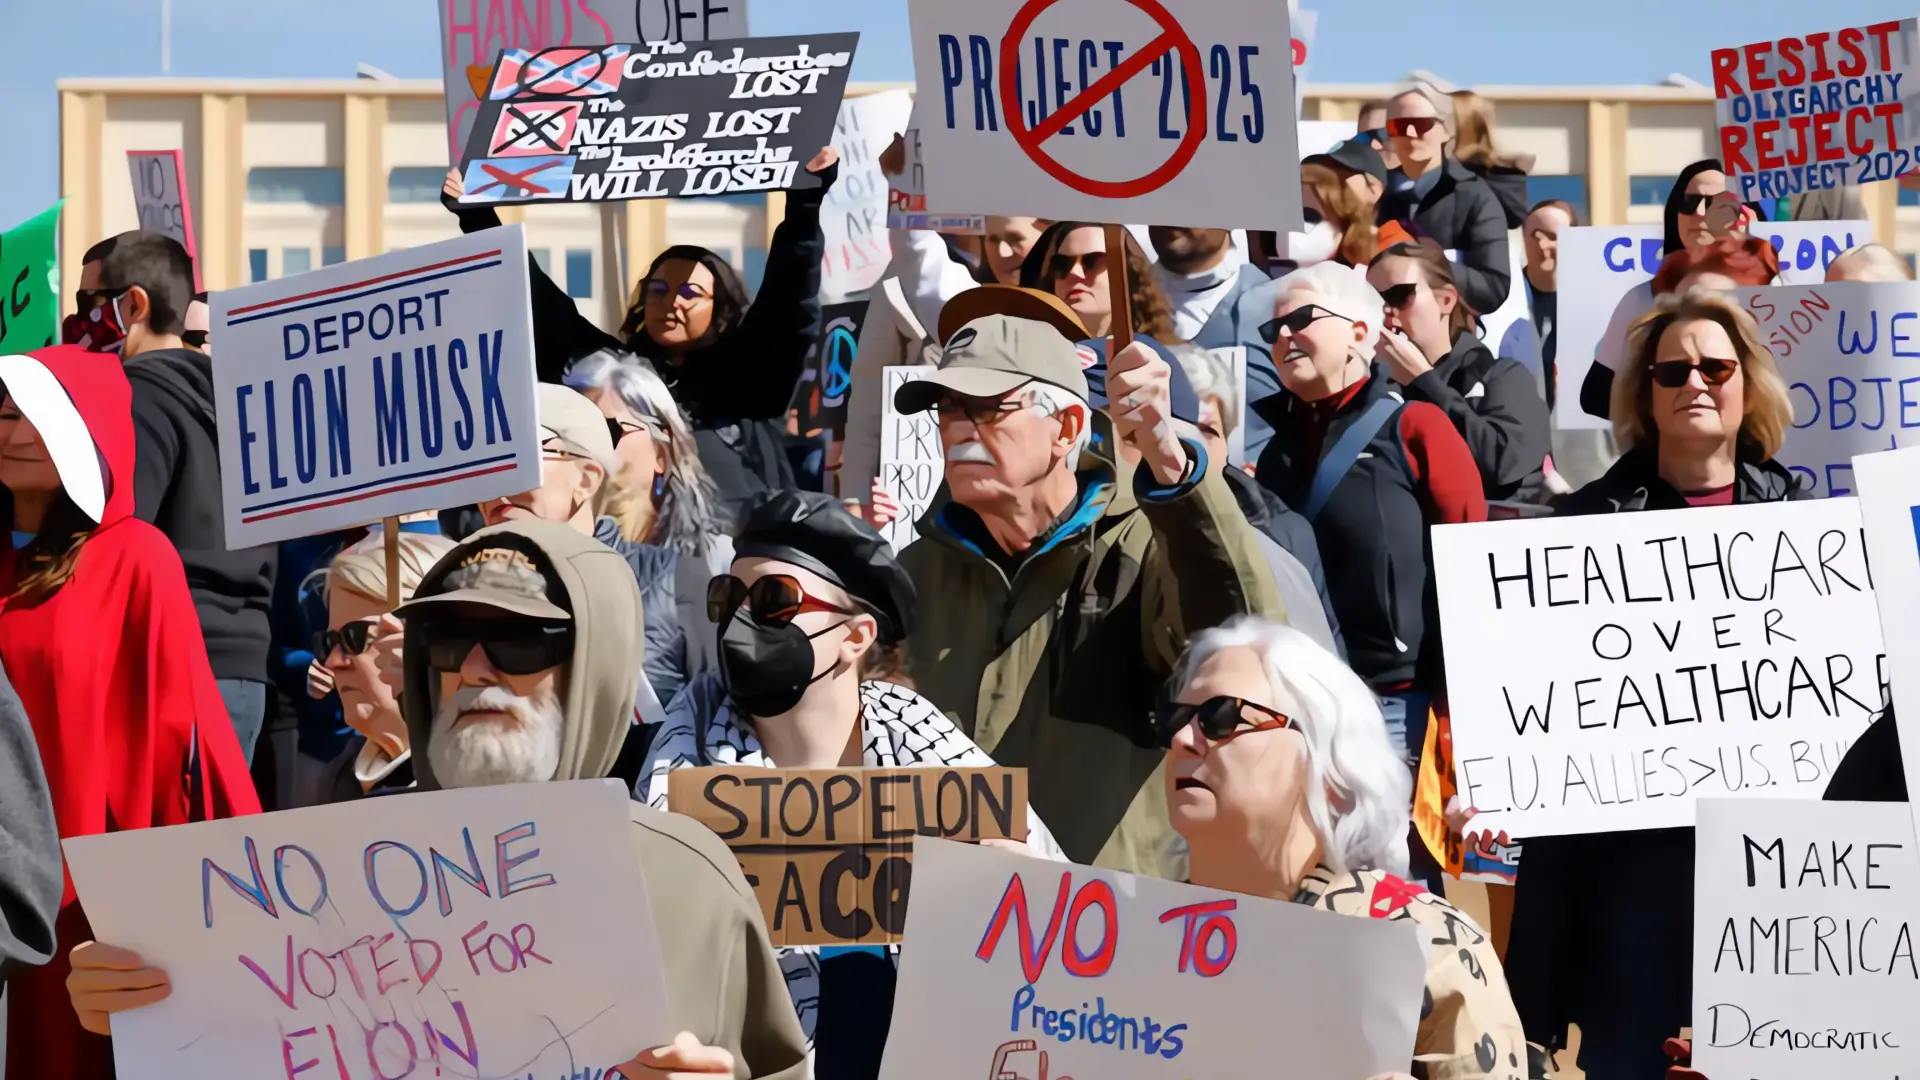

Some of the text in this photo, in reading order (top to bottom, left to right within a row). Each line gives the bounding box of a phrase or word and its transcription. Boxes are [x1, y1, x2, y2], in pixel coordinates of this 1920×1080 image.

[728, 67, 829, 99] LOST
[938, 33, 1125, 138] PRJECT
[1710, 20, 1900, 99] RESIST
[568, 106, 802, 147] NAZIS LOST
[1732, 73, 1903, 123] OLIGARCHY
[1720, 103, 1903, 177] REJECT
[570, 169, 669, 201] WILL
[1740, 161, 1851, 202] PROJECT
[283, 288, 450, 361] DEPORT
[236, 329, 512, 496] ELON MUSK
[1592, 608, 1797, 660] OVER
[202, 822, 557, 928] NO ONE
[1742, 833, 1903, 890] MAKE
[975, 871, 1119, 985] NO
[1713, 915, 1919, 980] AMERICA
[238, 920, 553, 1010] VOTED FOR
[1010, 981, 1188, 1060] Presidents
